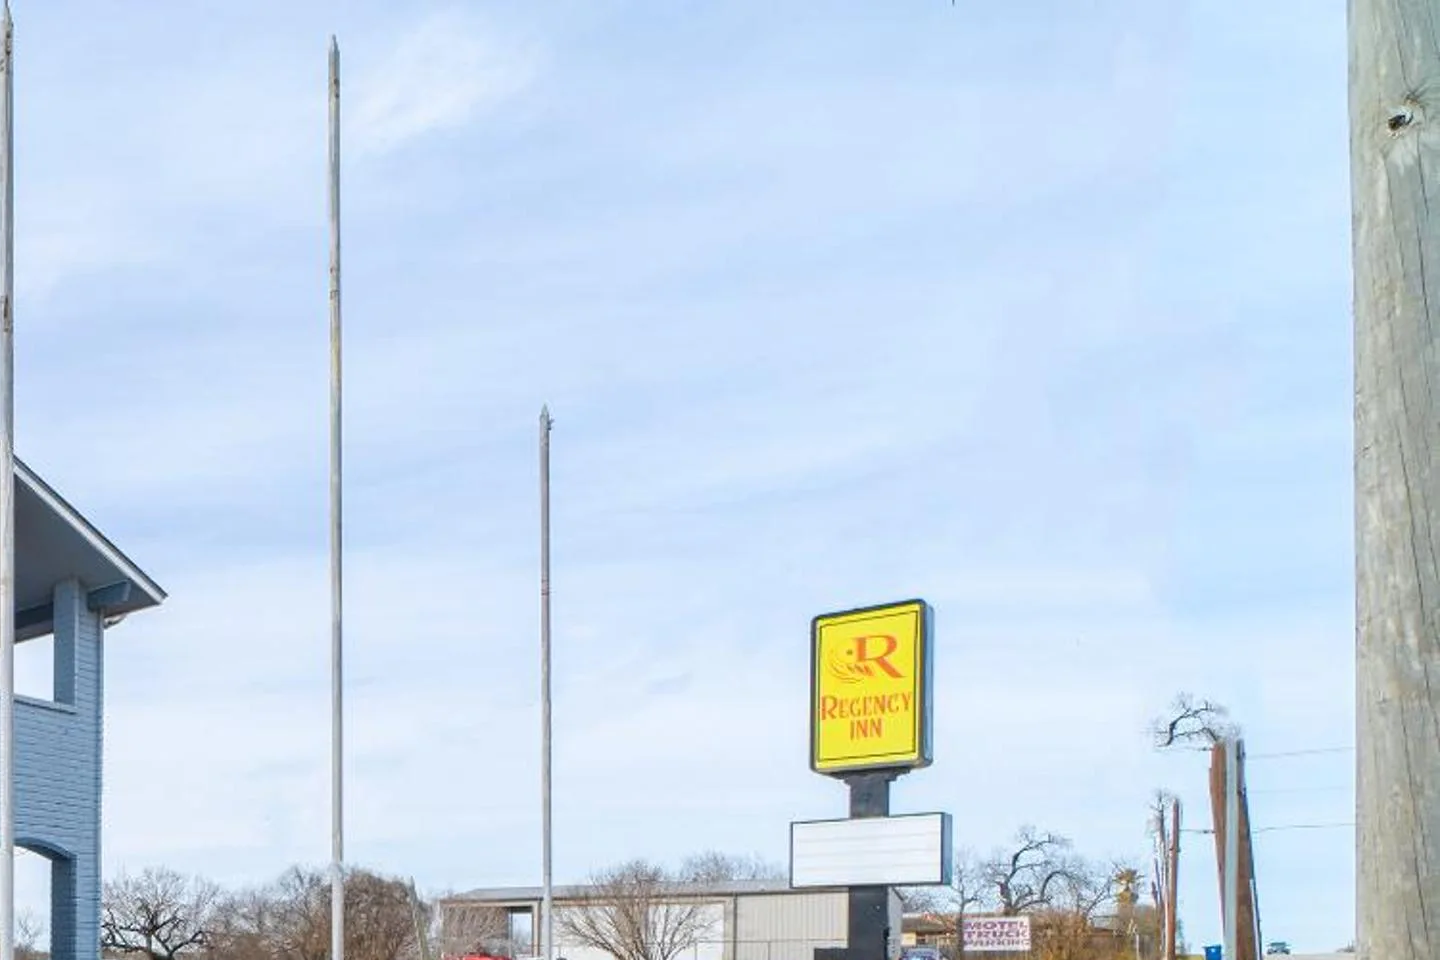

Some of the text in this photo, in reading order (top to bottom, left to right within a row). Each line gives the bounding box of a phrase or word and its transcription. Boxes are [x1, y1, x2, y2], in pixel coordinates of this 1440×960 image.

[821, 691, 913, 721] REGENCY
[850, 717, 883, 741] INN
[963, 921, 1028, 930] MOTEL
[963, 931, 1029, 939] TRUCK
